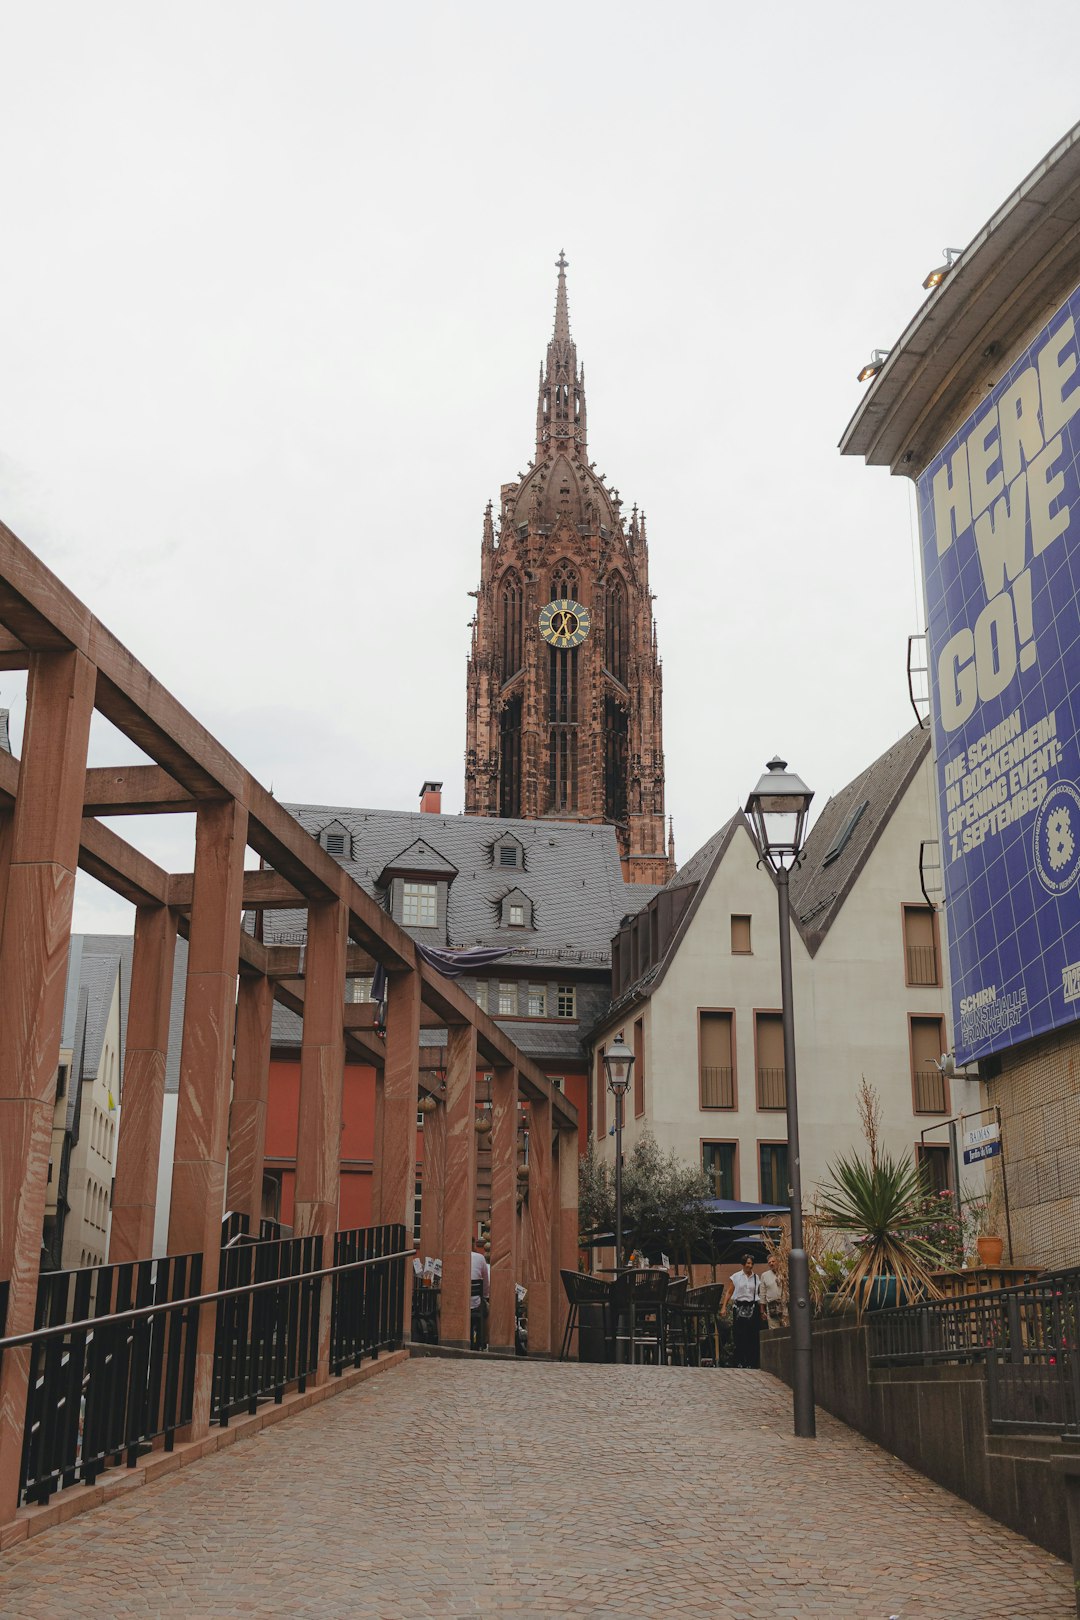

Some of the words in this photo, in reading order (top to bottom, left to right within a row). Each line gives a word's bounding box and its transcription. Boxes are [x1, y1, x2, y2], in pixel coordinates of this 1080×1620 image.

[933, 316, 1080, 557] HERE
[974, 434, 1070, 601] WE
[938, 568, 1036, 733] GO!
[944, 752, 967, 789] DIE
[967, 709, 1021, 769] SCHIRN
[946, 784, 960, 813] IN
[962, 711, 1057, 801] BOCKENHEIM
[948, 776, 1008, 837] OPENING
[1009, 738, 1063, 795] EVENT:
[950, 836, 962, 864] 7.
[962, 776, 1048, 855] SEPTEMBER
[960, 985, 996, 1015] SCHIRN
[961, 987, 1028, 1028] KUNSTHALLE
[962, 1008, 1021, 1047] FRANKFURT
